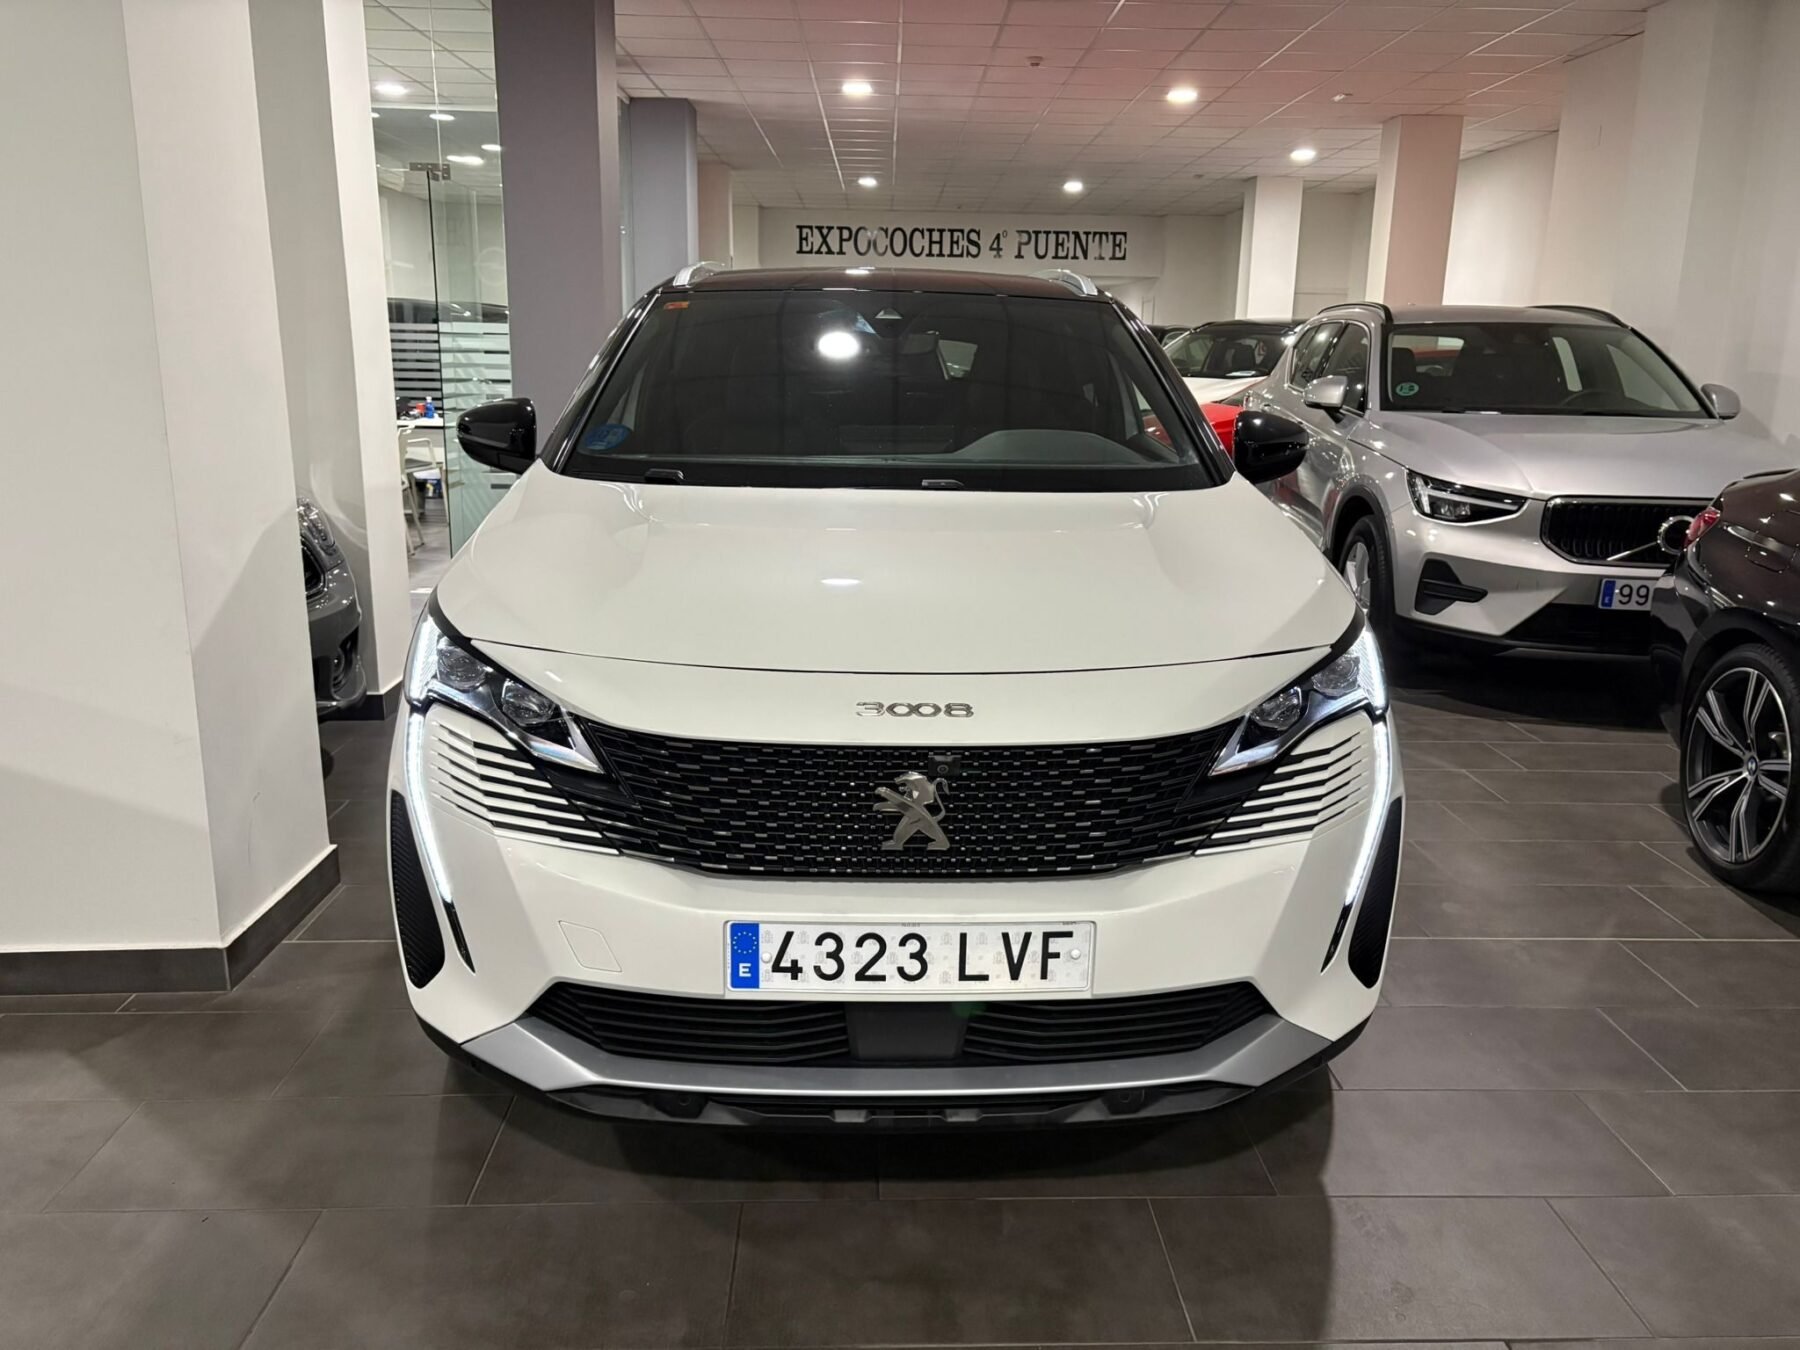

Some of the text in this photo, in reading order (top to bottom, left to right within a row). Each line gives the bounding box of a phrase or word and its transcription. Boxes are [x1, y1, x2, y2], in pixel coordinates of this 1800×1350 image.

[796, 225, 981, 258] EXPOCOCHES
[1014, 230, 1128, 260] PUENTE
[856, 701, 974, 718] 3008
[771, 930, 1074, 982] 4323 LVF
[738, 962, 752, 977] E
